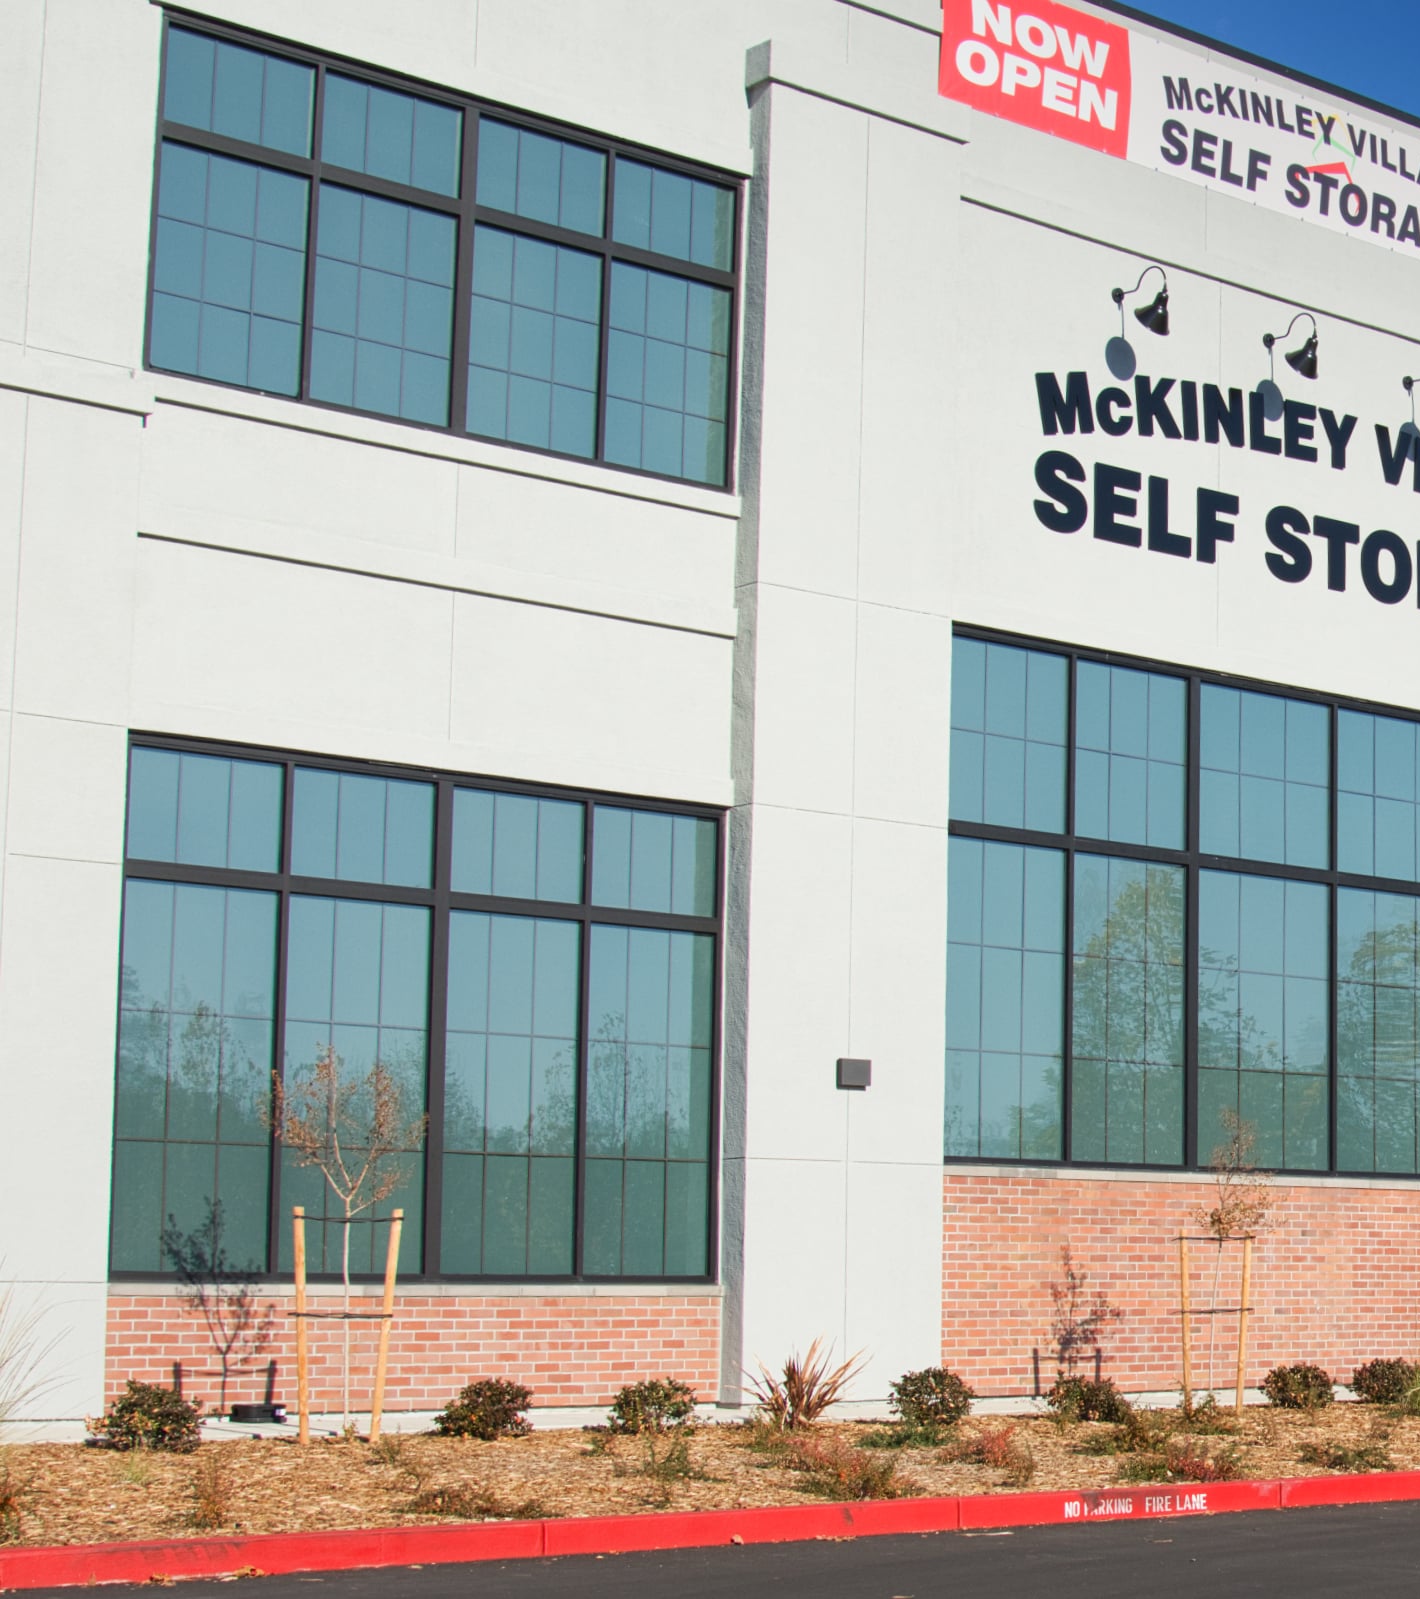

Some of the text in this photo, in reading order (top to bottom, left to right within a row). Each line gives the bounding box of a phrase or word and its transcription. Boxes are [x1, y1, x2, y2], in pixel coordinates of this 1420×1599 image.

[971, 0, 1110, 79] NOW
[955, 39, 1118, 132] OPEN
[1162, 75, 1336, 145] McKINLEY
[1160, 119, 1272, 192] SELF
[1034, 371, 1358, 470] McKINLEY
[1033, 450, 1239, 564] SELF
[1064, 1500, 1081, 1518] NO
[1145, 1495, 1172, 1513] FIRE
[1176, 1493, 1208, 1511] LANE
